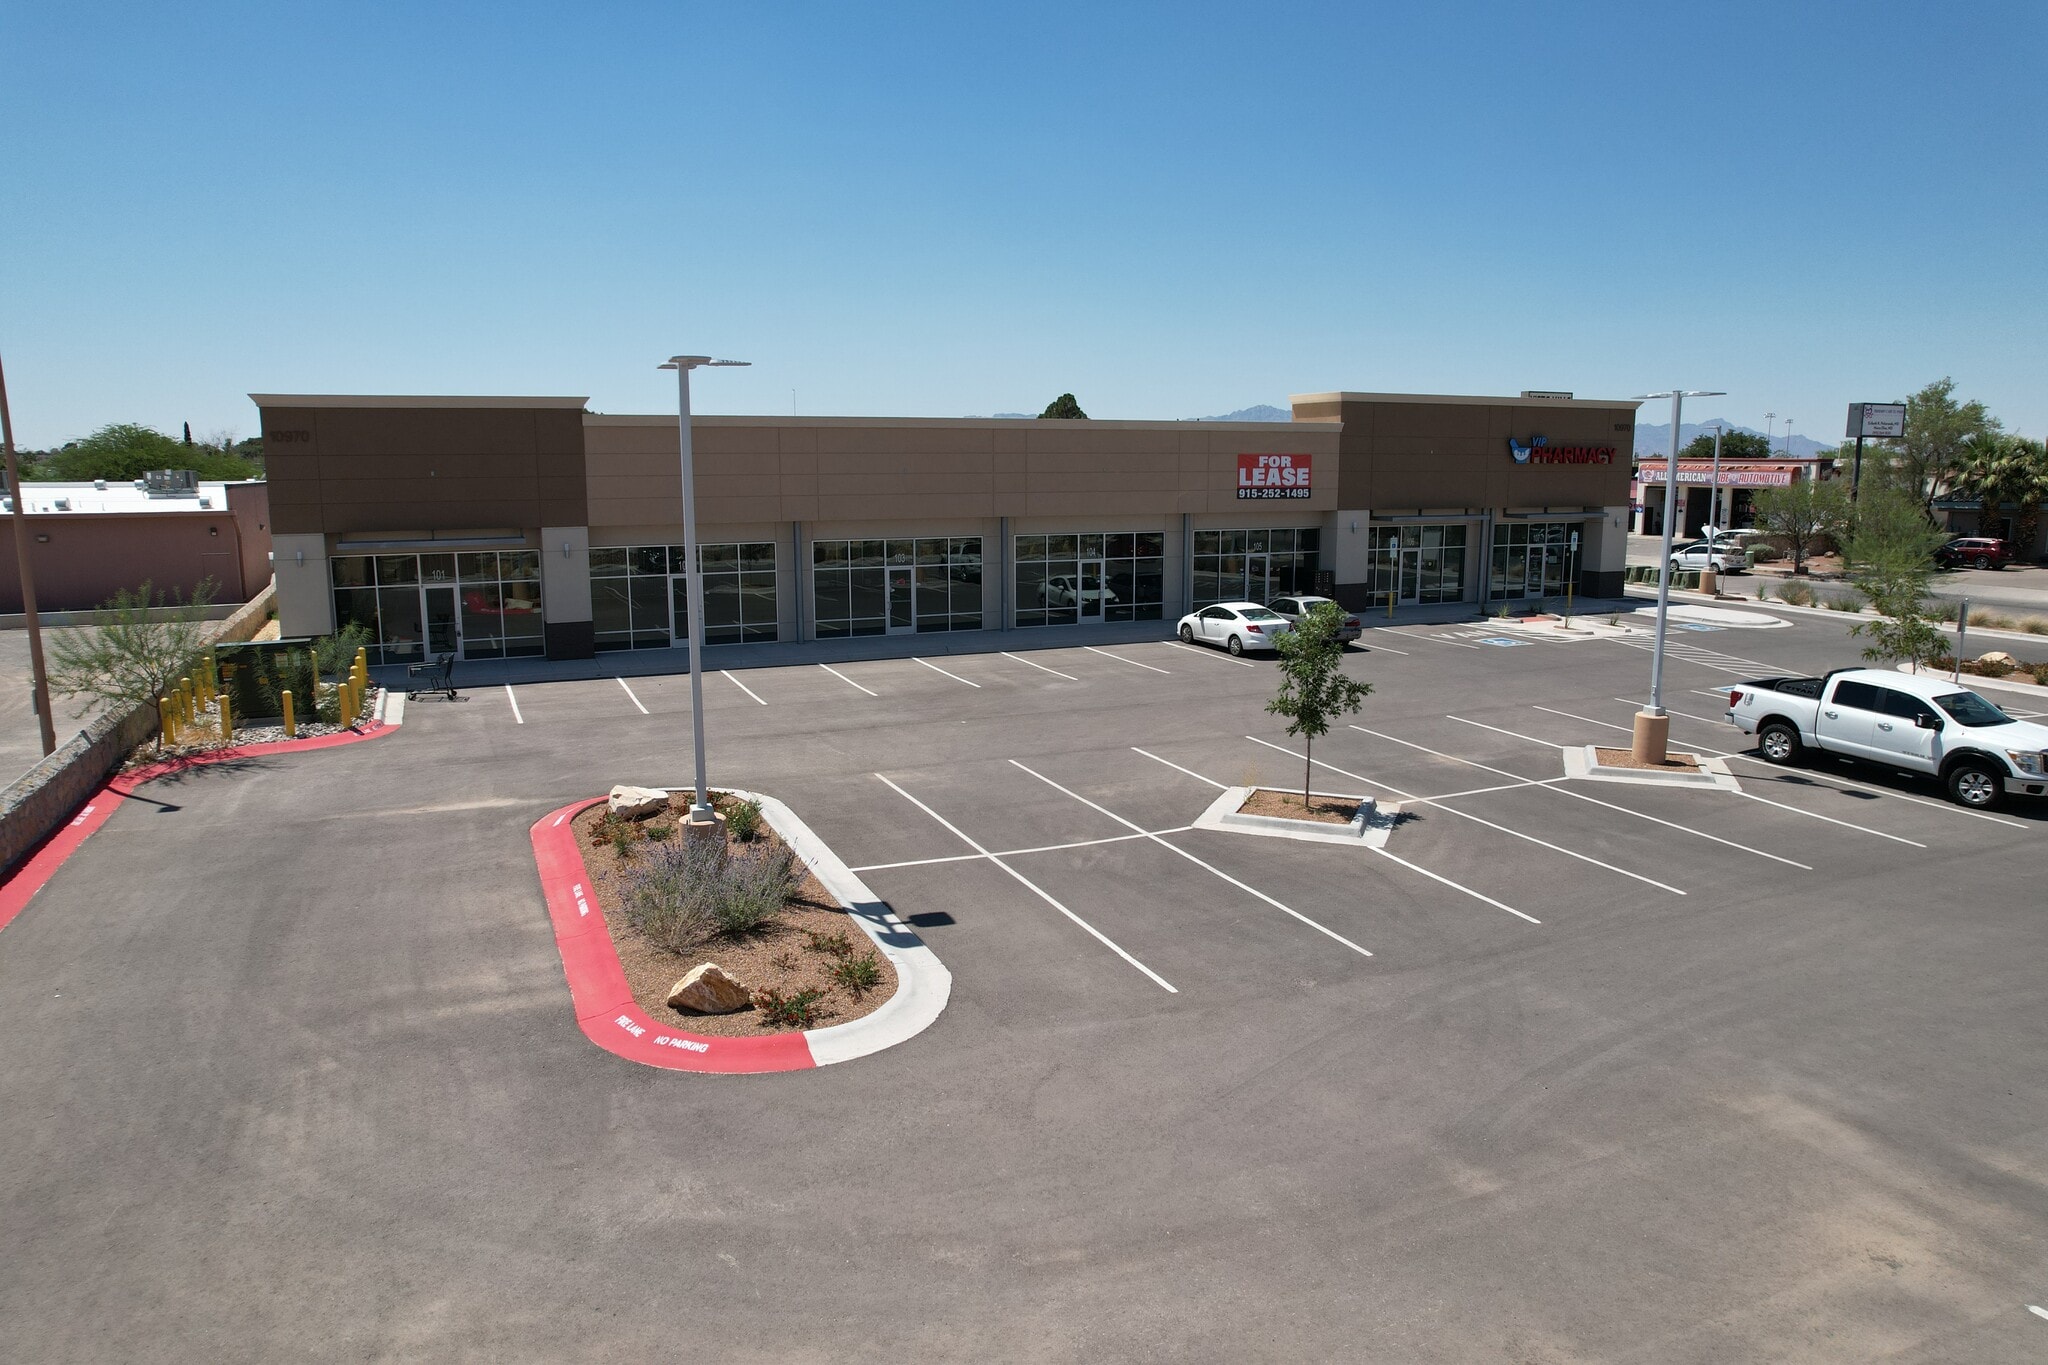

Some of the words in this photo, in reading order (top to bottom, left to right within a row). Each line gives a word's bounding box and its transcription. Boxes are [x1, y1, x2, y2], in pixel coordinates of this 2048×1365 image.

[270, 430, 309, 443] 10970
[1532, 436, 1547, 447] VIP
[1258, 455, 1292, 468] FOR
[1530, 447, 1617, 464] PHARMACY
[1239, 468, 1309, 486] LEASE
[1655, 471, 1668, 481] ALL
[1675, 472, 1707, 482] MERICAN
[1738, 473, 1787, 484] AUTOMOTIVE
[1238, 488, 1309, 498] 915-252-1495
[895, 553, 906, 563] 103
[432, 569, 445, 580] 101
[626, 1022, 646, 1038] LANE
[653, 1035, 670, 1046] NO
[668, 1038, 709, 1053] PARKING
